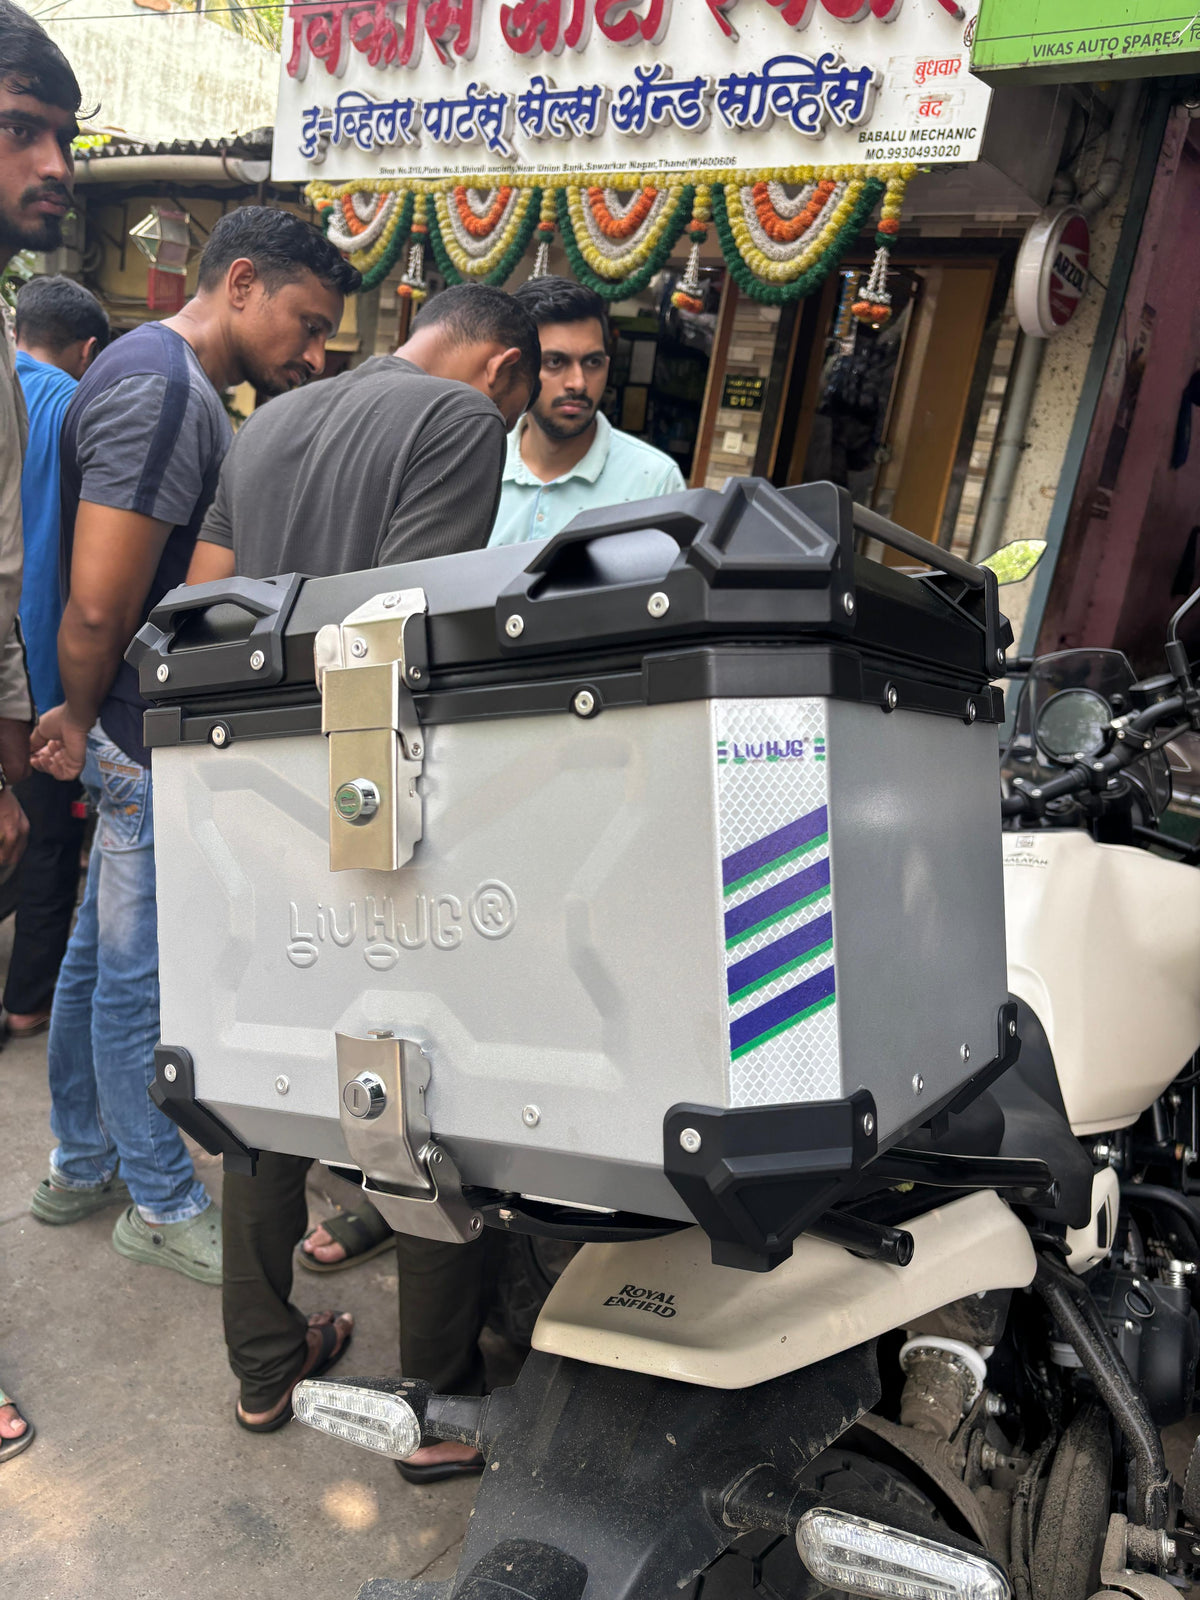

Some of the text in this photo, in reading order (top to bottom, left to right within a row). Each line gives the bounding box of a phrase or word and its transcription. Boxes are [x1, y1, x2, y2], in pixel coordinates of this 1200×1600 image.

[1032, 41, 1074, 58] VIKAS
[1076, 37, 1119, 54] AUTO
[914, 59, 961, 85] बुधवार
[919, 96, 943, 117] बंद
[858, 128, 977, 143] BABALU MECHANIC
[619, 1284, 675, 1305] ROYAL
[603, 1296, 677, 1318] ENFIELD
